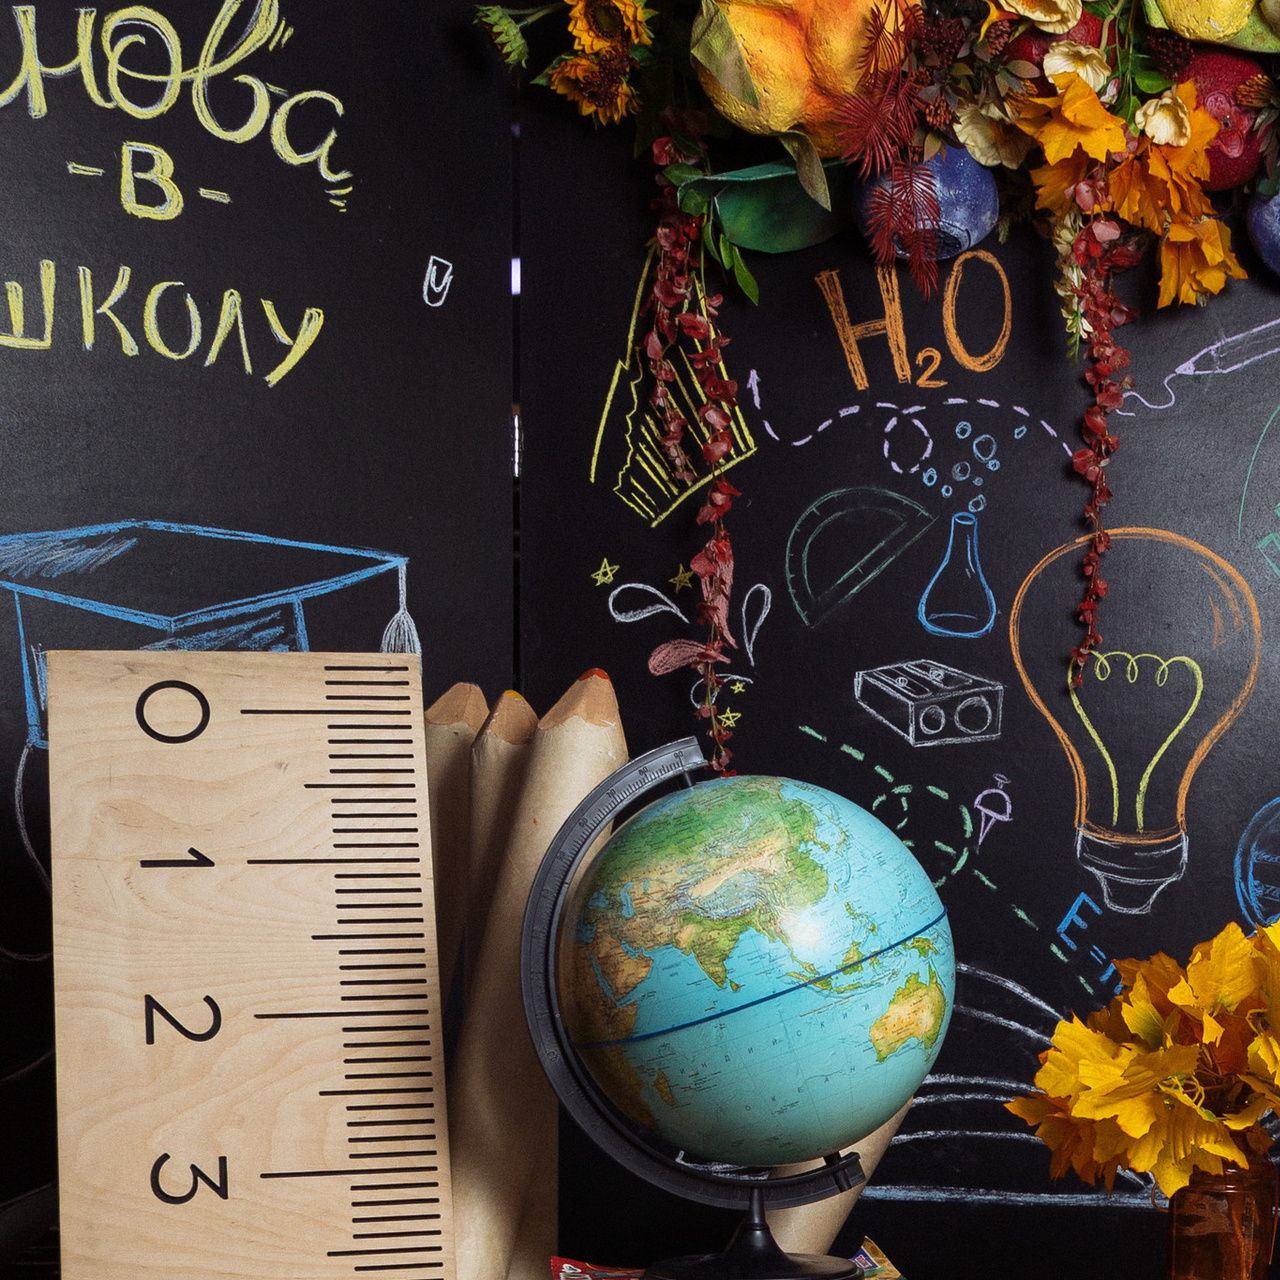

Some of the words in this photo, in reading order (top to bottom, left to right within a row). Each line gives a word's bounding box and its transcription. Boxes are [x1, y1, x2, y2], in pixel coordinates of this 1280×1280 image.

[135, 680, 211, 744] 0
[140, 847, 215, 868] 1
[144, 994, 222, 1044] 2
[150, 1152, 228, 1204] 3
